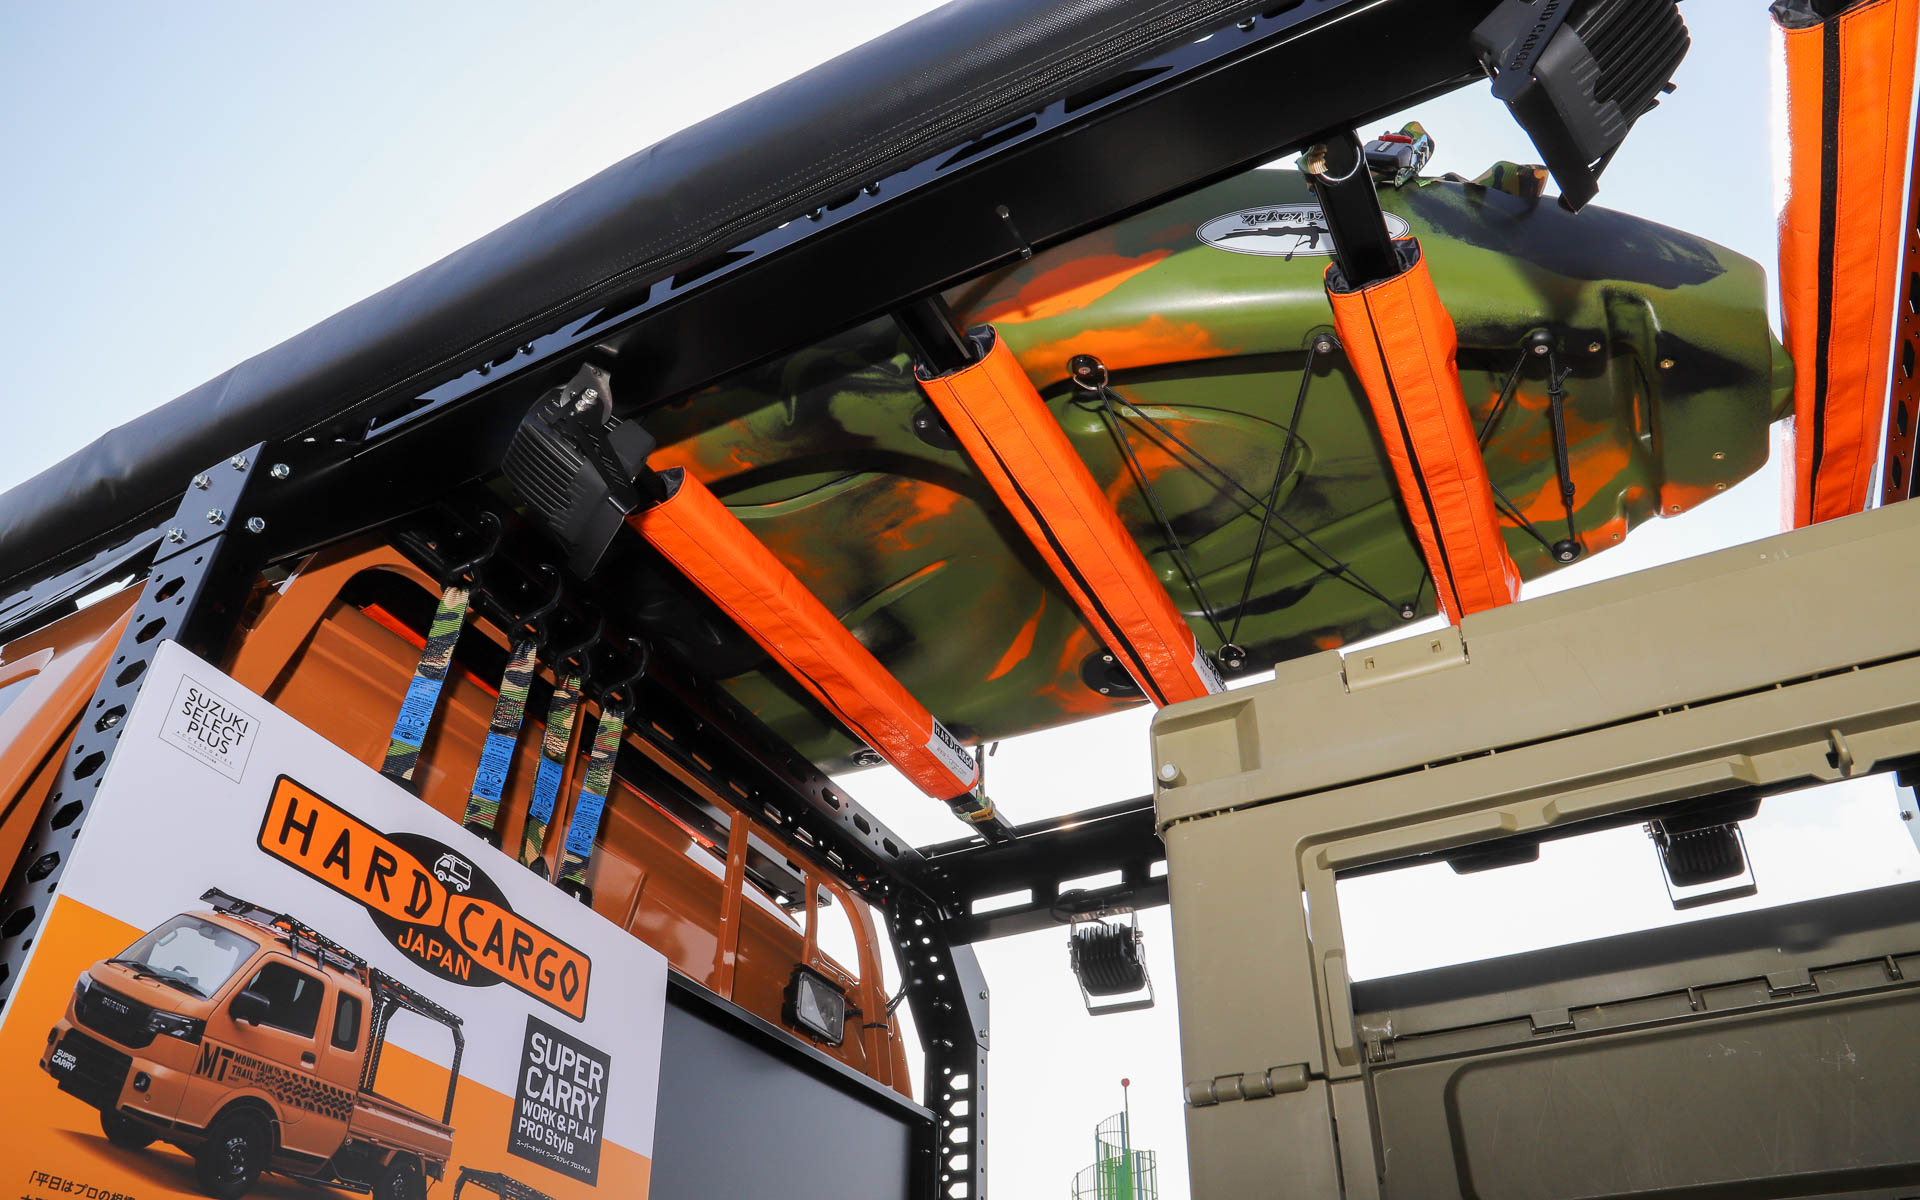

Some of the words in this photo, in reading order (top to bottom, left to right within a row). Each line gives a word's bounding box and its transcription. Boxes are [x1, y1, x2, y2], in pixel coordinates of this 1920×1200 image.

[1510, 24, 1546, 71] CARGO
[182, 701, 245, 746] SELECT
[187, 688, 249, 734] SUZUKI
[176, 730, 233, 766] ACCESSORIES
[187, 720, 230, 754] PLUS
[935, 723, 955, 749] HARD
[954, 744, 974, 769] CARGO
[278, 797, 433, 919] HARD
[458, 902, 579, 1002] CARGO
[398, 927, 471, 981] JAPAN
[102, 996, 129, 1015] SUZUKI
[51, 1055, 77, 1071] CARRY
[56, 1048, 77, 1064] SUPER
[195, 1042, 235, 1082] MT
[231, 1064, 254, 1083] TRAIL
[233, 1052, 274, 1074] MOUNTAIN
[529, 1031, 604, 1094] SUPER
[525, 1065, 600, 1124] CARRY
[518, 1116, 544, 1141] PRO
[545, 1126, 575, 1155] Style
